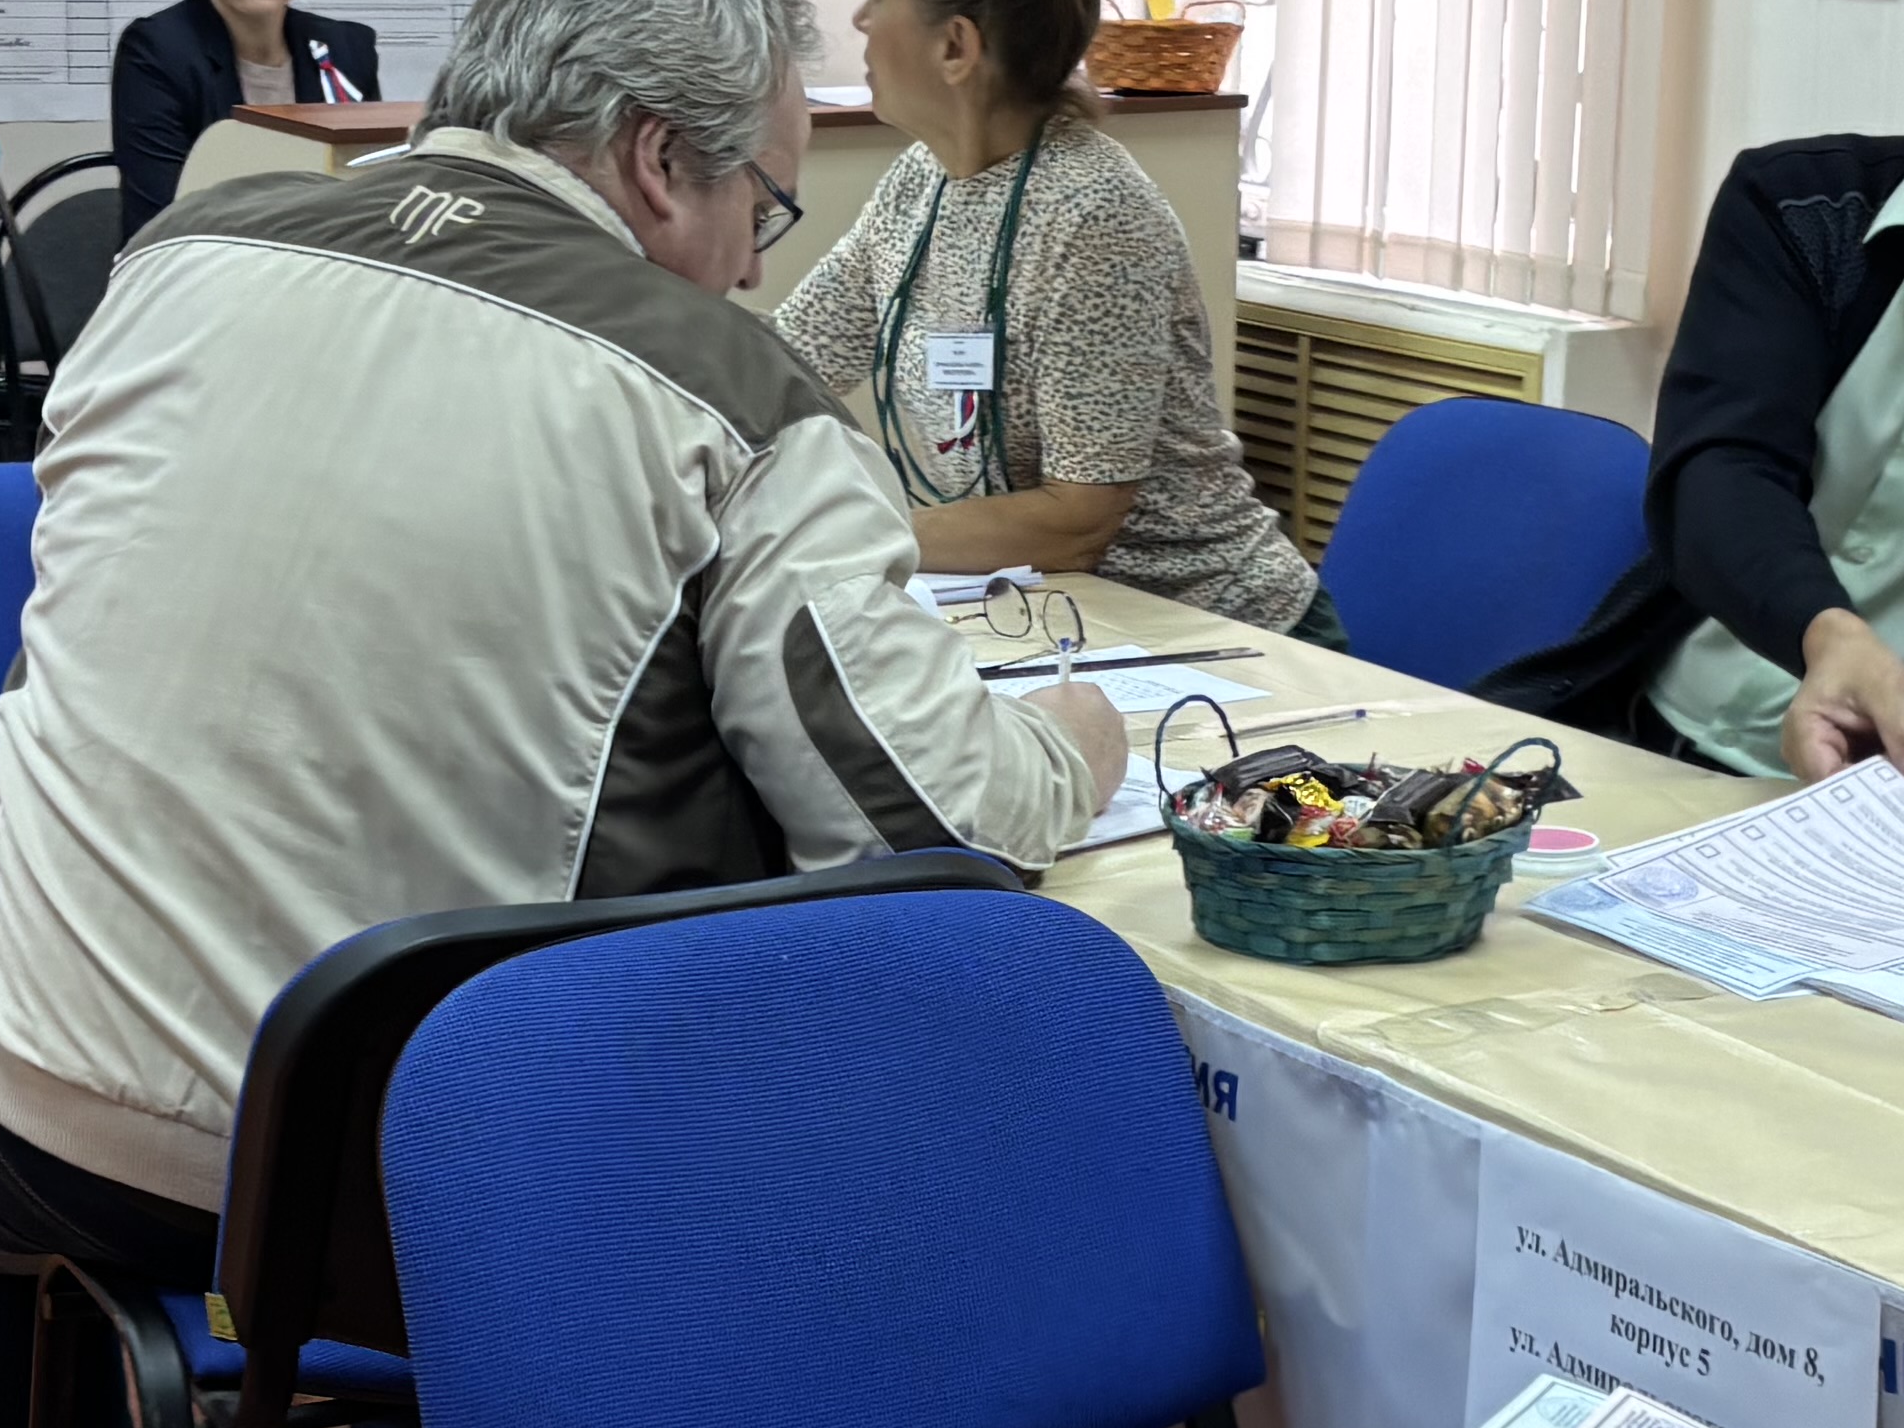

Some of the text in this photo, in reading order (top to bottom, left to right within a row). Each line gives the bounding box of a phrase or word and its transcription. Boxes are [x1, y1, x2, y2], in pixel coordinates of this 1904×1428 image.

[1515, 1225, 1825, 1386] ул. Адмиральского, дом 8,
[1509, 1326, 1540, 1357] ул.
[1610, 1313, 1712, 1376] корпус 5
